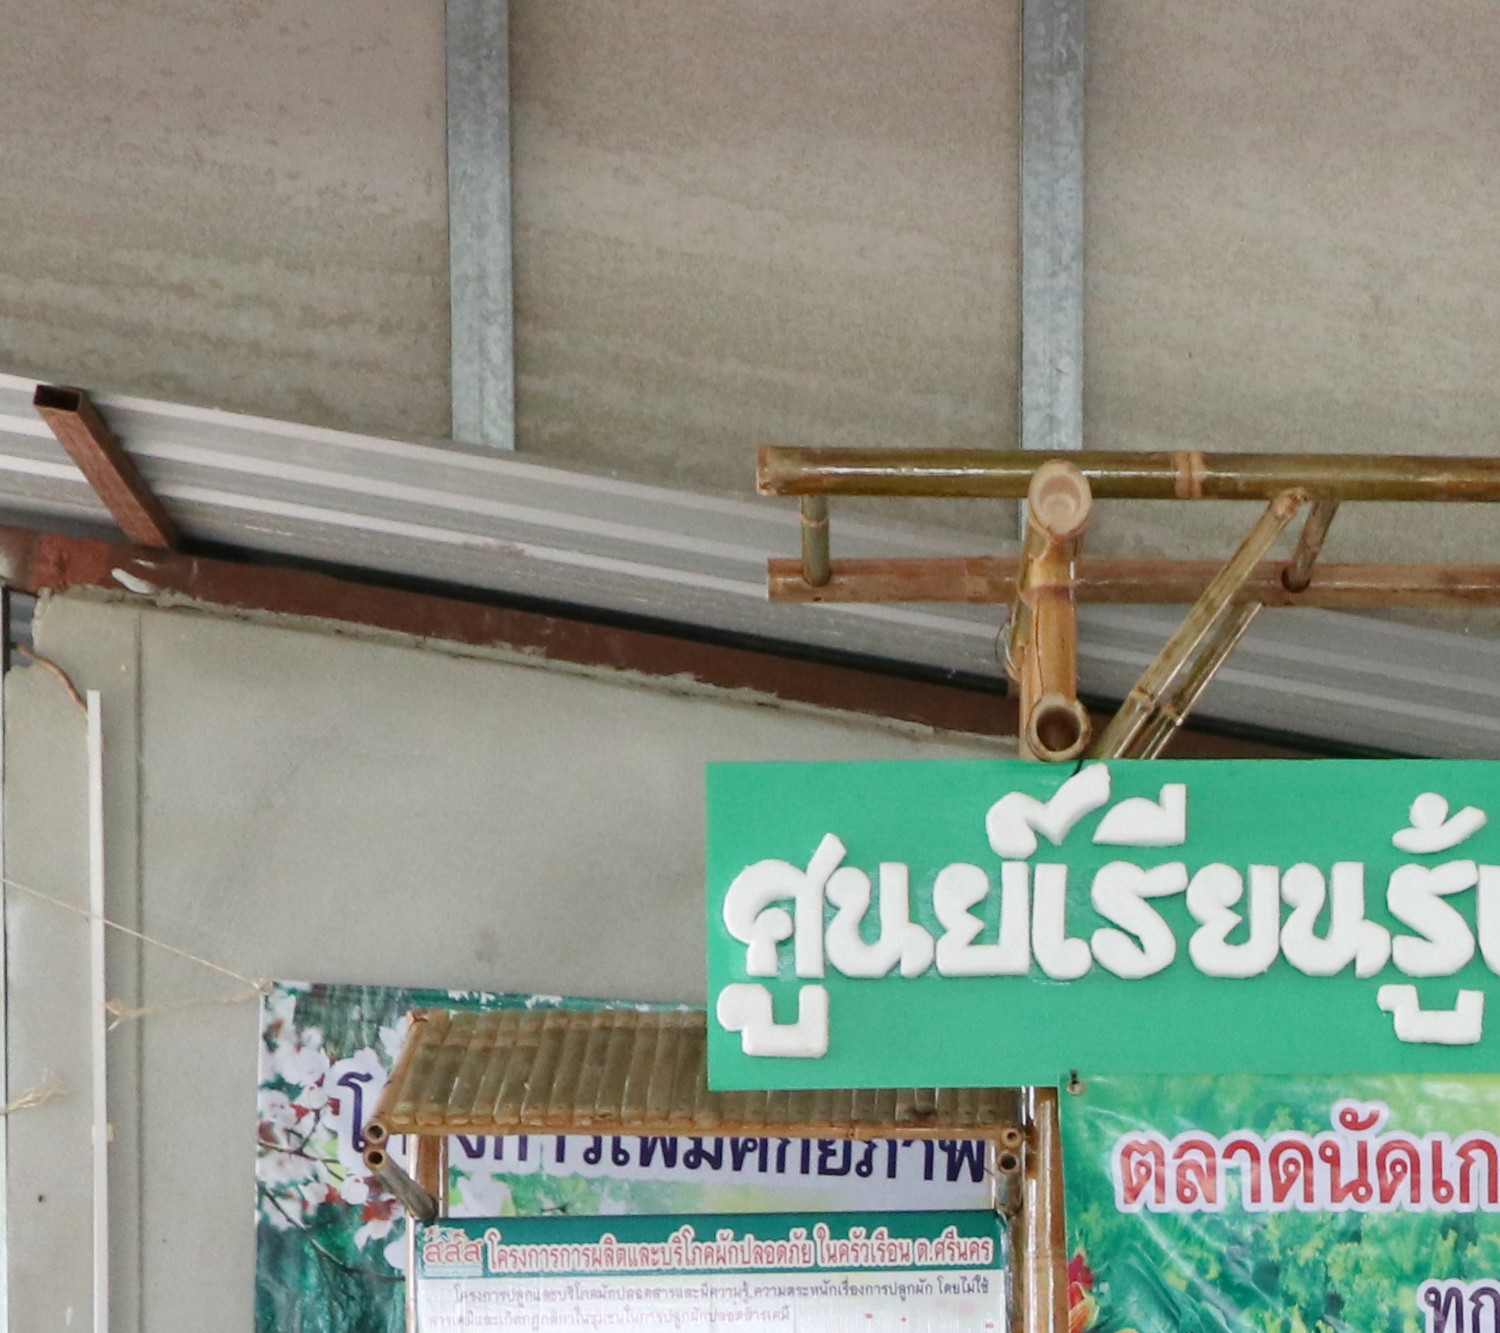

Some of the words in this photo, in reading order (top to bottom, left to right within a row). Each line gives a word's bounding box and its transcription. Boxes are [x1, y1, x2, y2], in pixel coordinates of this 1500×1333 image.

[817, 1225, 911, 1267] ในครัวเรือน
[916, 1228, 991, 1263] ต.ศรีนคร
